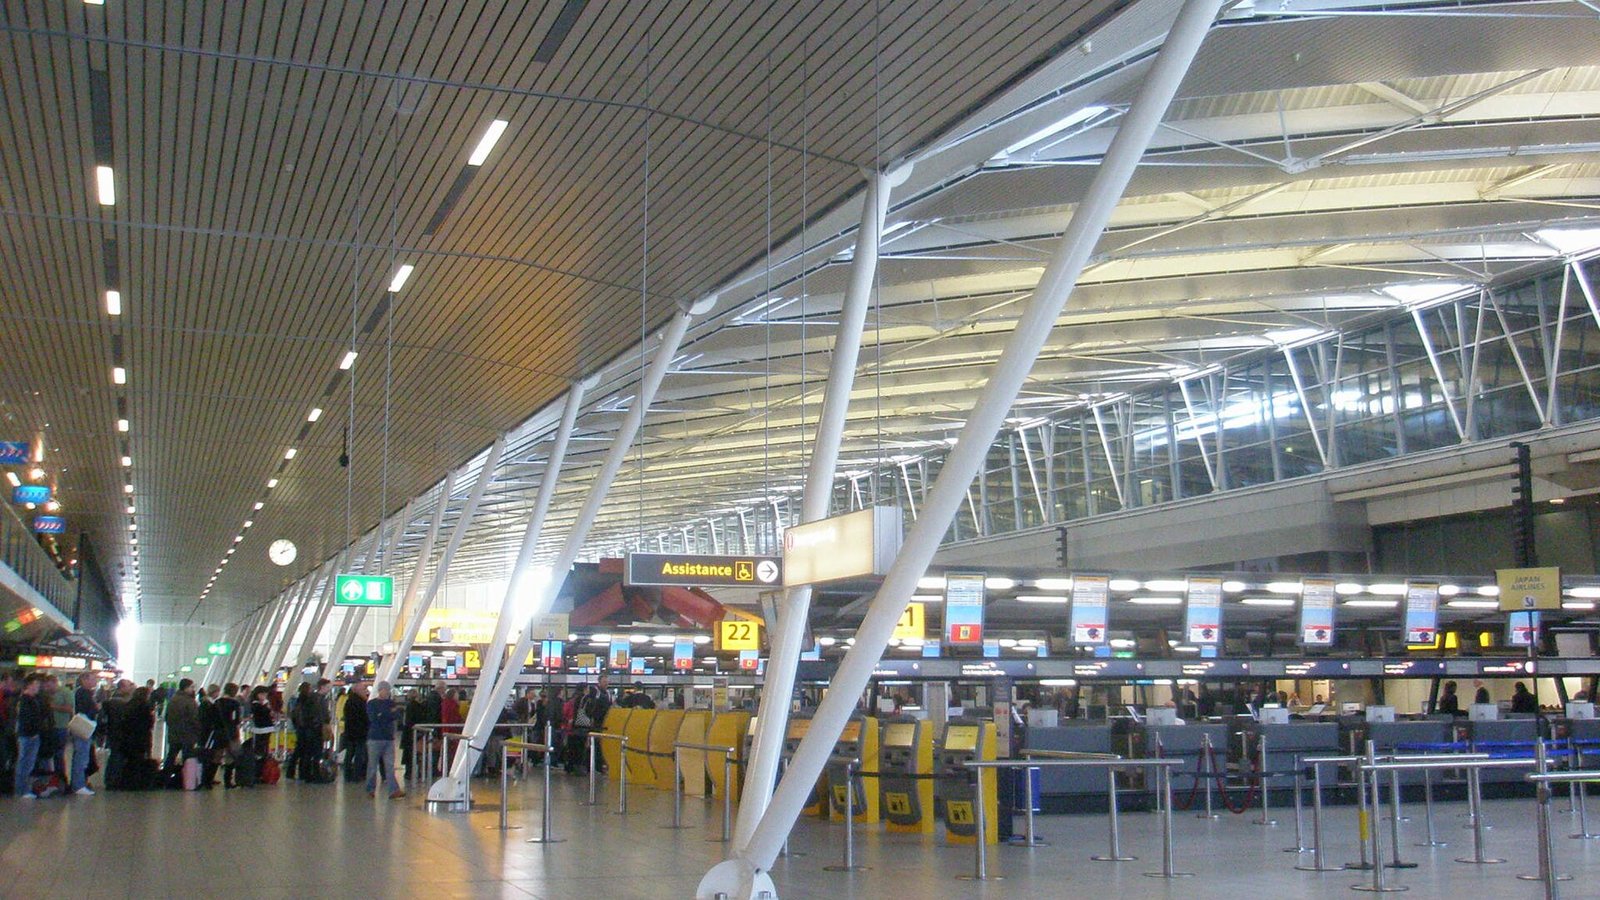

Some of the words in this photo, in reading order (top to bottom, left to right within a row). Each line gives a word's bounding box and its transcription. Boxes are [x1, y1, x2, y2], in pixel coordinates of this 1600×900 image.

[661, 562, 732, 576] Assistance
[897, 606, 914, 627] 1
[727, 623, 751, 641] 22
